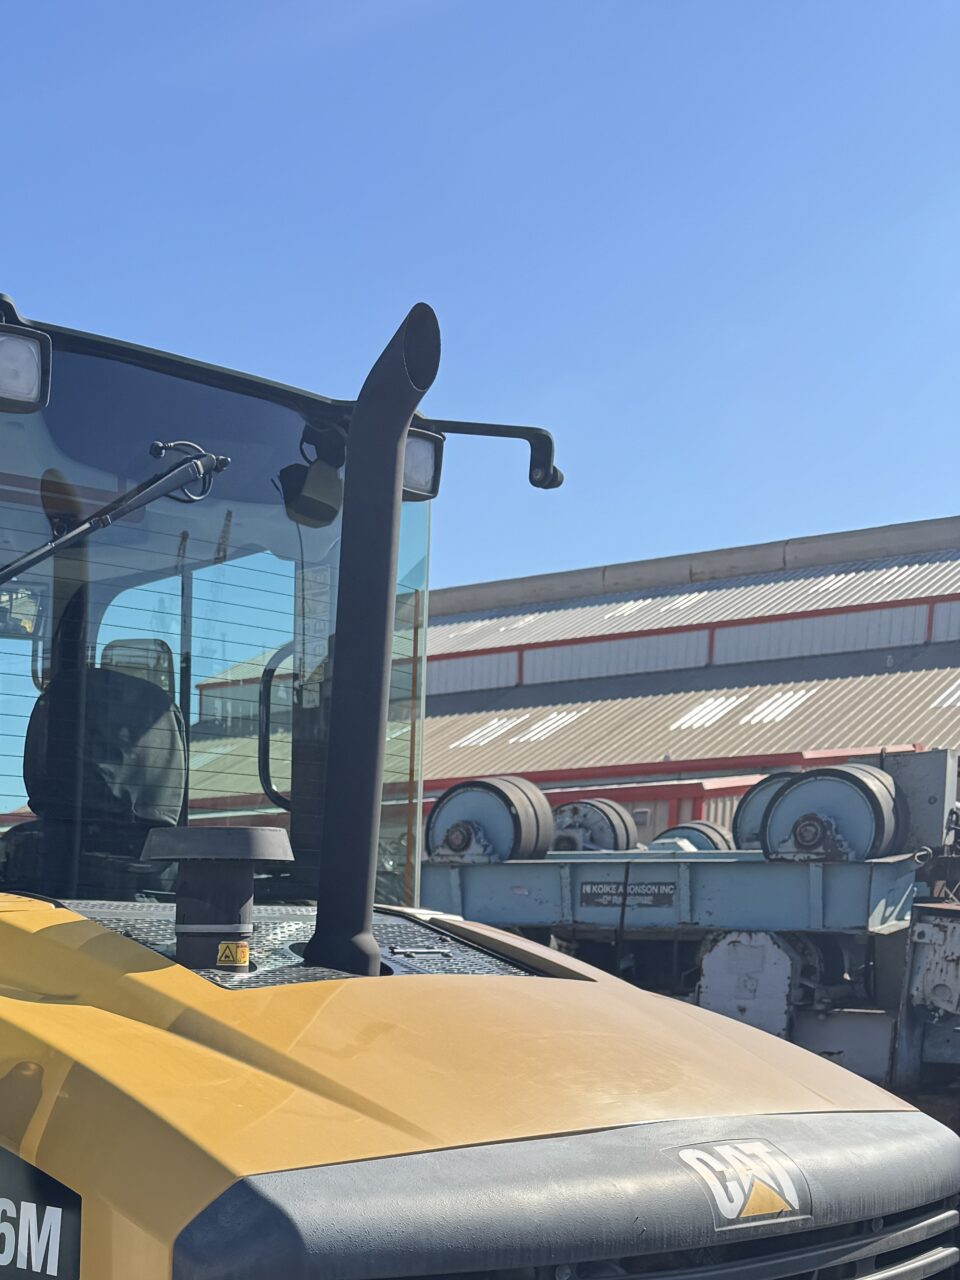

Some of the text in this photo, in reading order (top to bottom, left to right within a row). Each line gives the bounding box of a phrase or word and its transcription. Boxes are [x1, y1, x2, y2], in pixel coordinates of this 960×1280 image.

[592, 885, 675, 894] KOIKE AONSON INC
[678, 1141, 800, 1219] CAT
